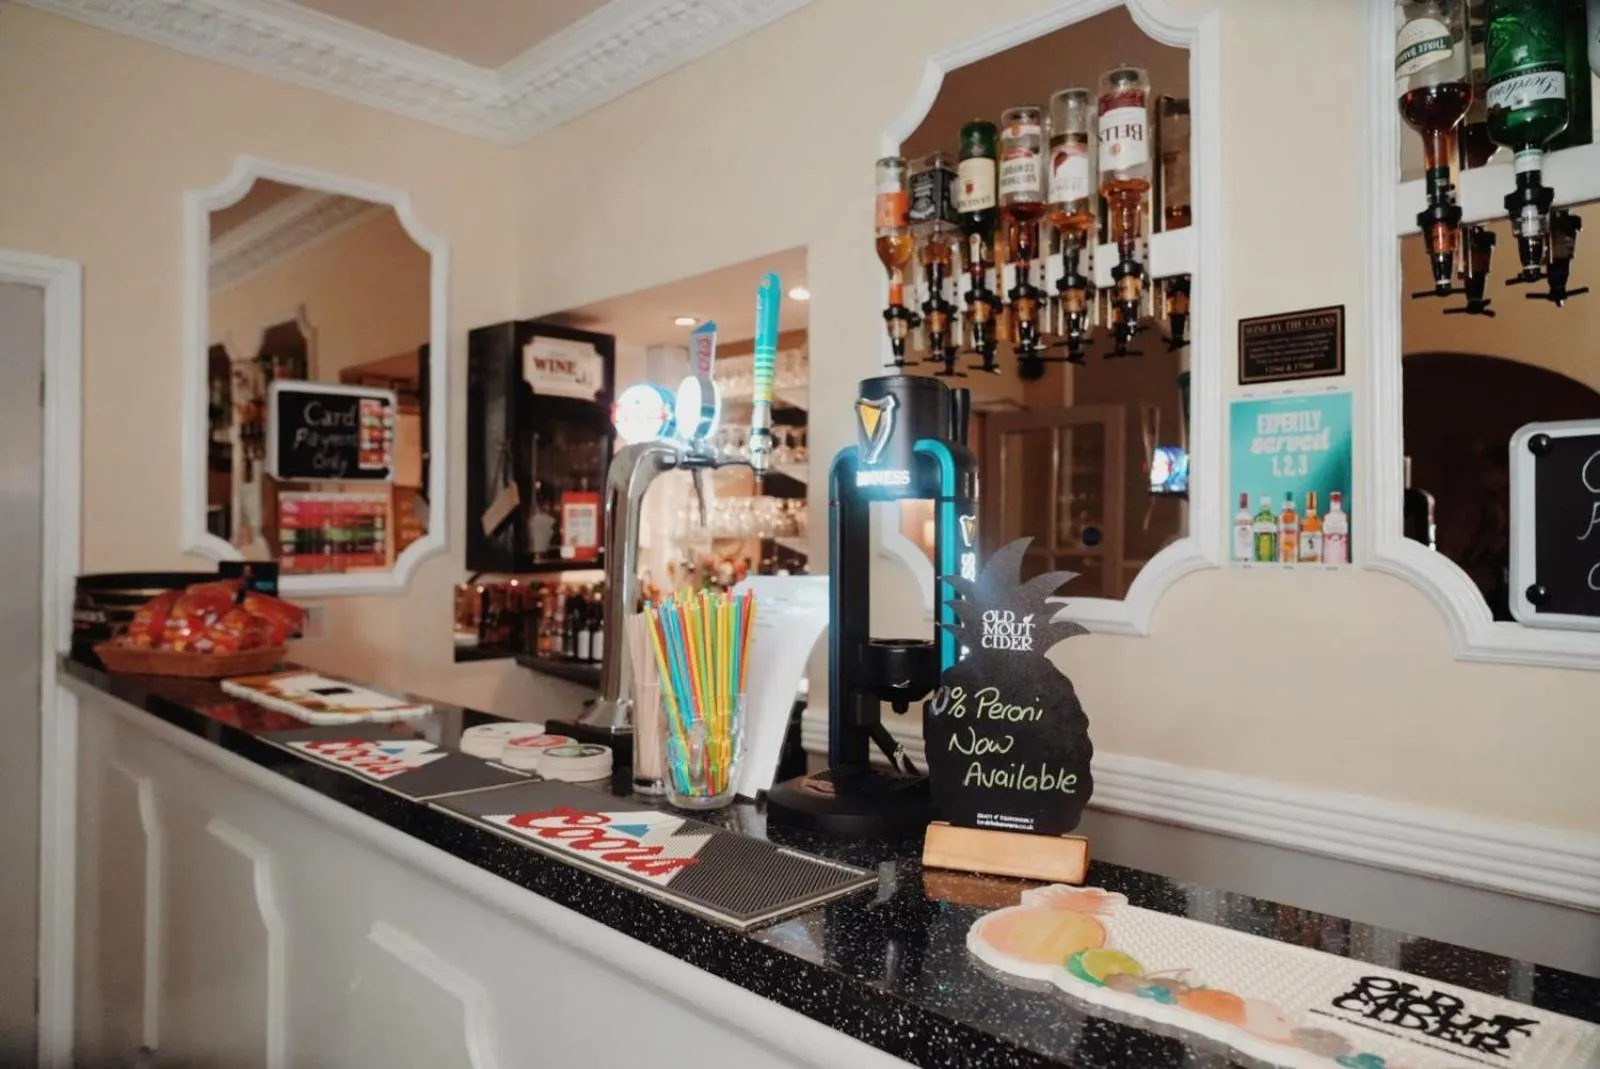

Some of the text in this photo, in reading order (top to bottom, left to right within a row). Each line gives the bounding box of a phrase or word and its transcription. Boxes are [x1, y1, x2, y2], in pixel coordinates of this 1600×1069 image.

[533, 355, 577, 376] WINE
[303, 400, 357, 427] Card
[1258, 411, 1322, 434] EXPERTLY
[981, 609, 1016, 623] OLD
[981, 621, 1036, 637] MOUT
[980, 634, 1033, 651] CIDER
[929, 684, 1044, 722] 0% Peroni
[948, 726, 1014, 756] Now
[963, 760, 1079, 794] Available
[507, 805, 699, 876] Coors
[1357, 976, 1464, 1011] OLD
[1332, 993, 1512, 1059] CIDER
